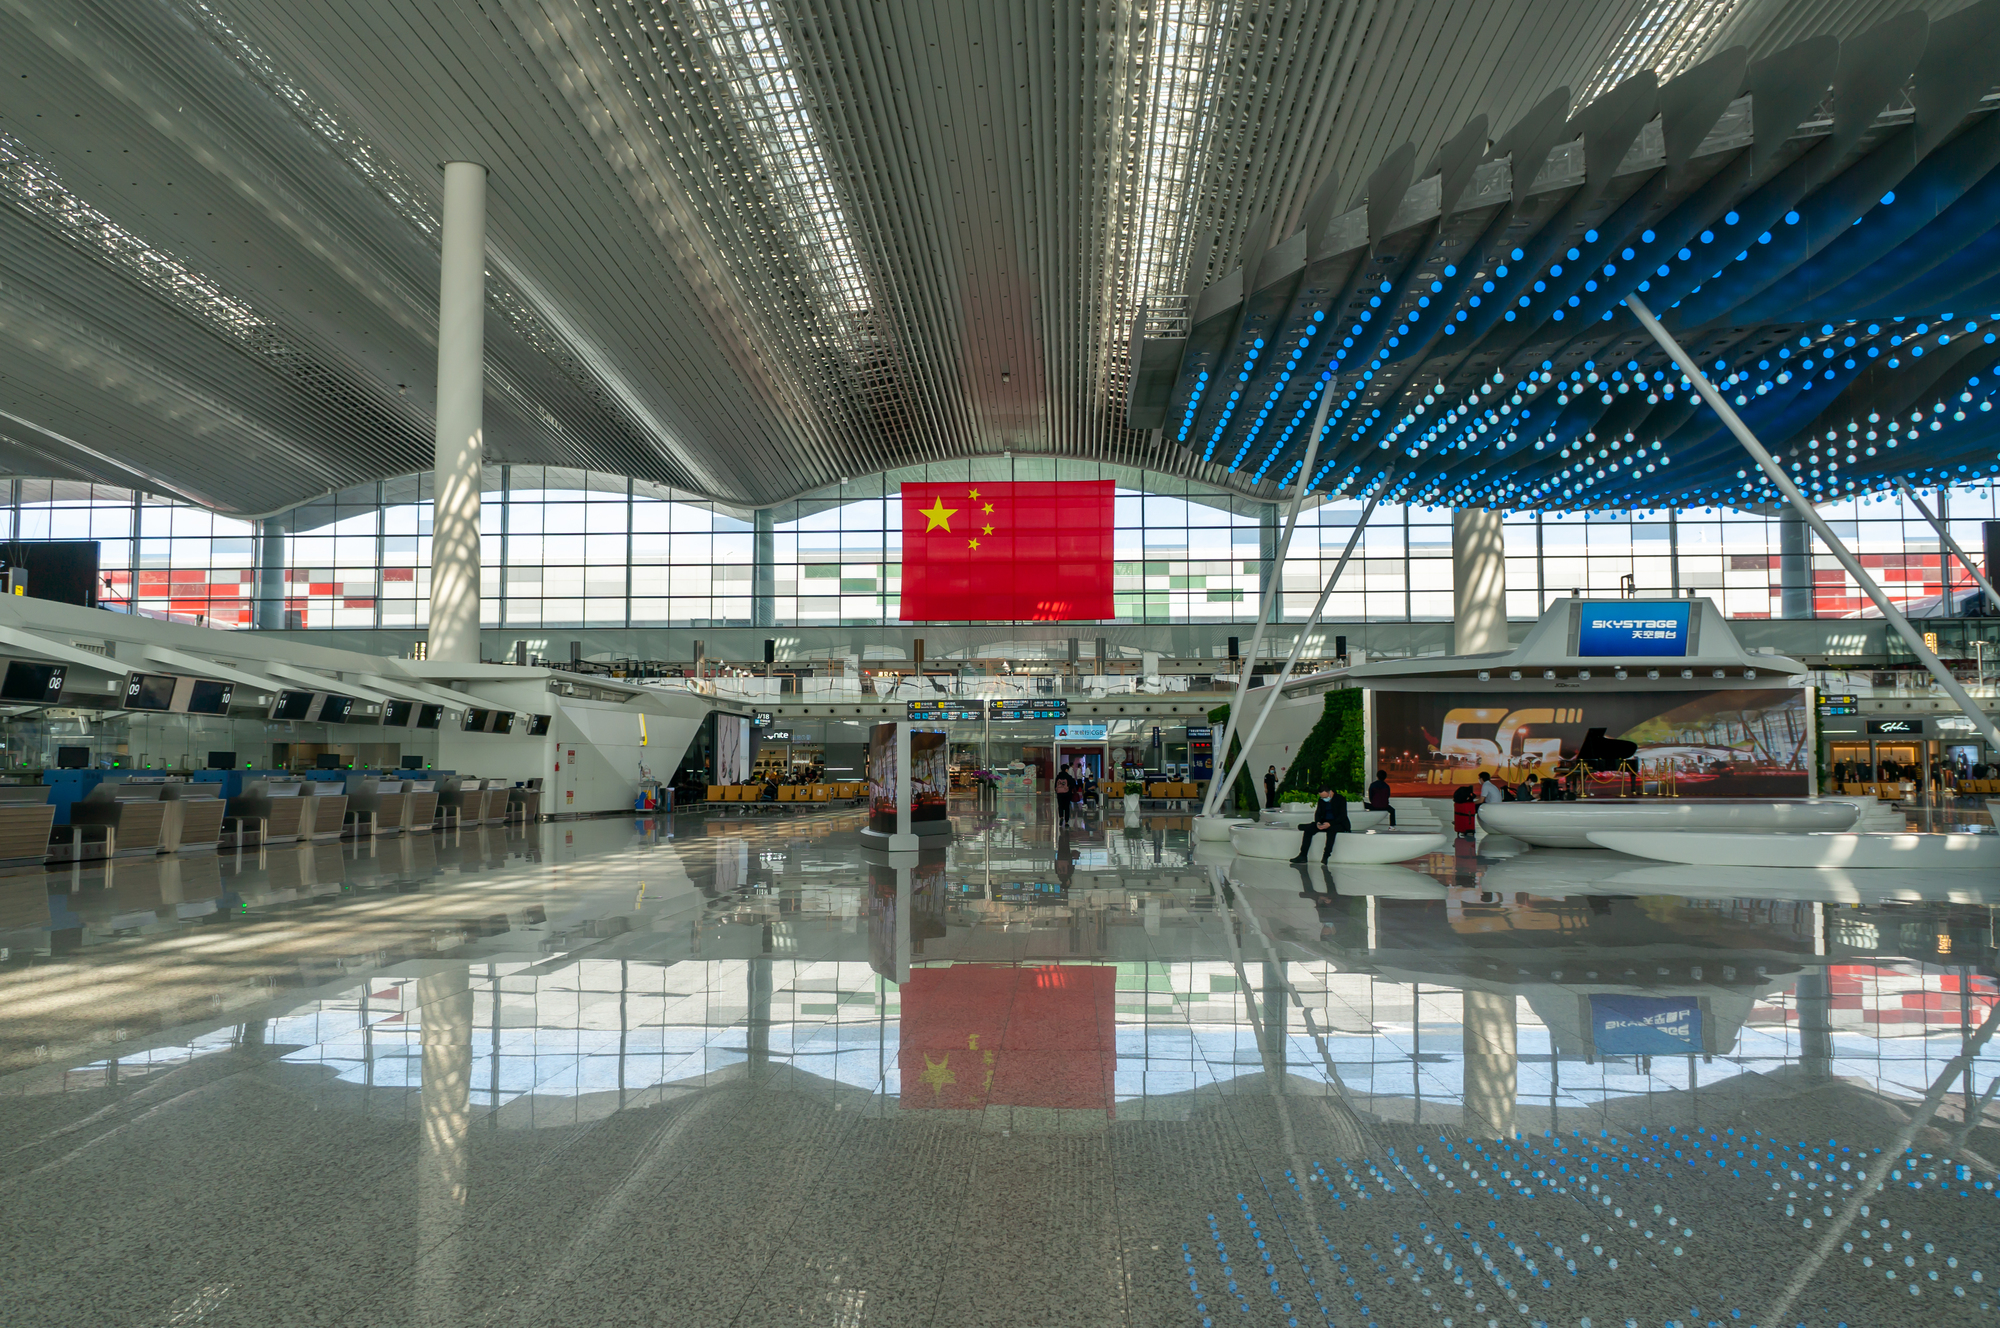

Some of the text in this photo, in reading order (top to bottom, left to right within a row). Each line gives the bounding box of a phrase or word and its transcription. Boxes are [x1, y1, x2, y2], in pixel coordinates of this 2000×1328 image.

[1632, 630, 1676, 639] 天空舞台
[49, 677, 62, 689] 08
[129, 684, 140, 695] 09
[222, 693, 231, 703] 10
[278, 699, 287, 708] 11
[343, 706, 351, 714] 12
[386, 708, 393, 716] 13
[1434, 708, 1564, 784] 5G
